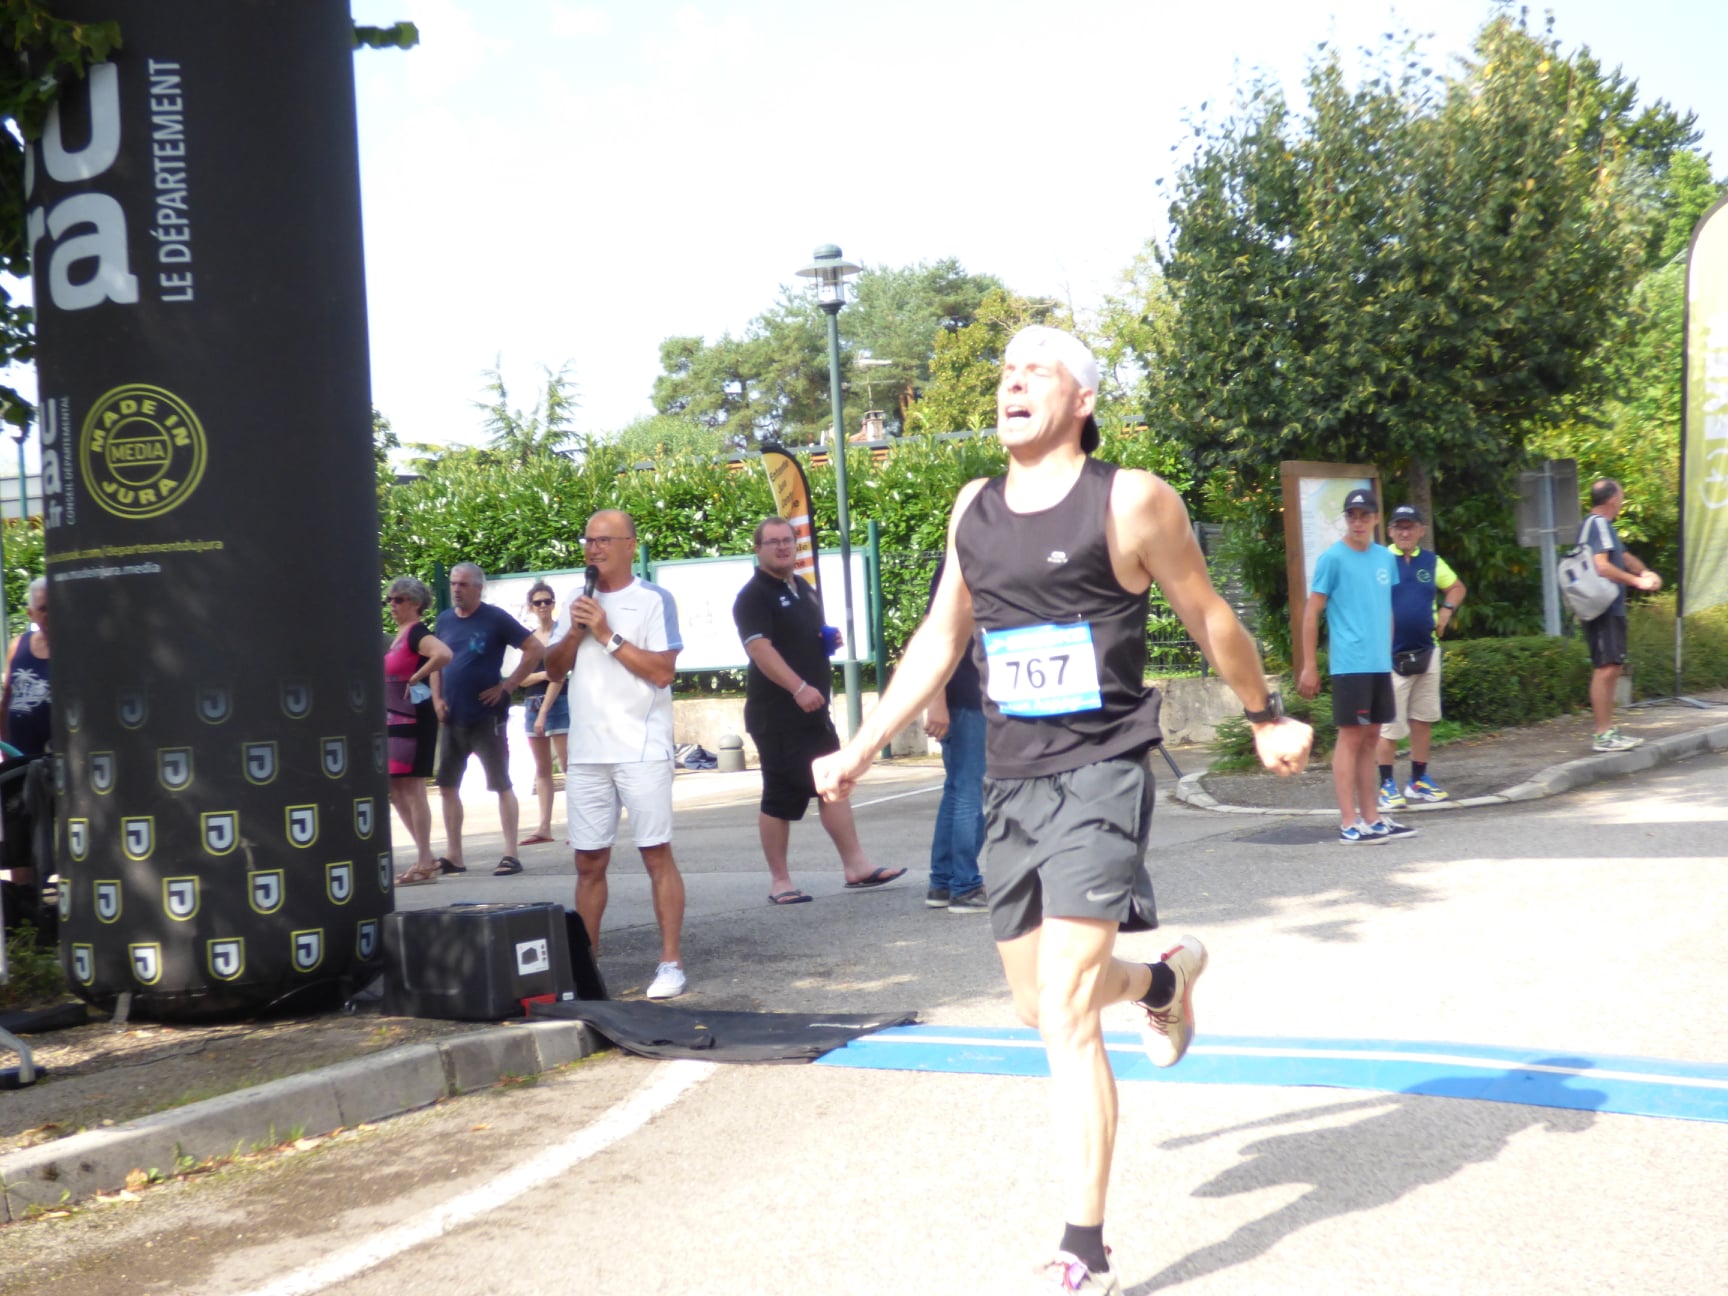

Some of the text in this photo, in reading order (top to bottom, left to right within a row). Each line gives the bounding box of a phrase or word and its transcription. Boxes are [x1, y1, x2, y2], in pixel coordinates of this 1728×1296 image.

[147, 58, 194, 303] LE DÉPARTEMENT
[91, 399, 191, 453] MADE IN
[111, 441, 166, 462] MEDIA
[102, 477, 179, 506] JURA
[1006, 654, 1071, 690] 767
[93, 754, 113, 788] J
[163, 751, 189, 786] J
[248, 746, 274, 779] J
[325, 741, 343, 773] J
[207, 816, 233, 850] J
[291, 810, 313, 843] J
[358, 803, 370, 835] J
[72, 823, 85, 856] J
[127, 822, 149, 854] J
[169, 881, 195, 915] J
[254, 875, 280, 909] J
[330, 867, 349, 899] J
[98, 886, 118, 918] J
[297, 934, 319, 967] J
[360, 924, 375, 956] J
[75, 949, 90, 981] J
[135, 947, 156, 980] J
[213, 942, 240, 976] J
